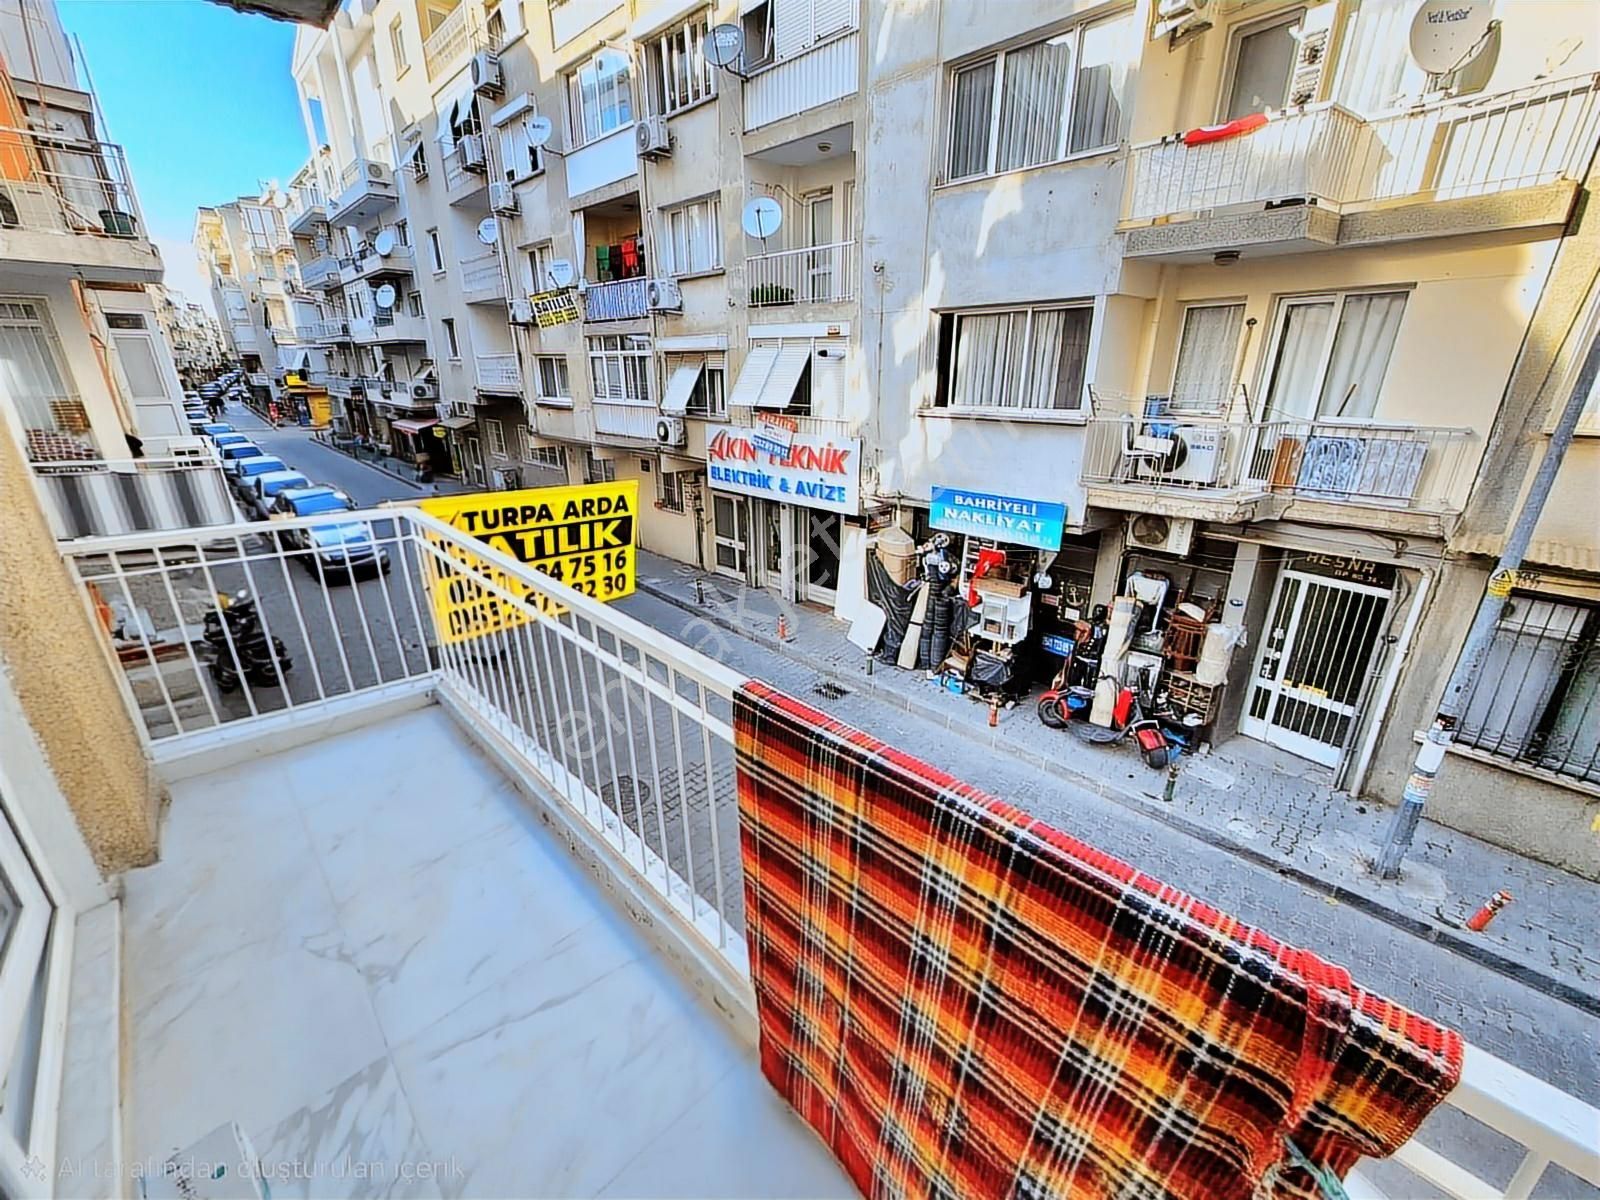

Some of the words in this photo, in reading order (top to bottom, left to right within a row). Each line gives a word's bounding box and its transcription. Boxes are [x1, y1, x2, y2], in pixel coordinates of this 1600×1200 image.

[708, 429, 757, 463] AKIN
[769, 441, 851, 476] KNİK
[710, 465, 774, 491] ELEKTRİK
[779, 476, 792, 494] &
[795, 478, 846, 503] AVİZE
[461, 503, 553, 532] TURPA
[562, 494, 629, 521] ARDA
[943, 507, 1046, 533] NAKLİYAT
[954, 494, 1037, 517] BAHRİYELİ
[466, 519, 623, 568] ATILIK
[568, 555, 596, 579] 75
[603, 550, 627, 572] 16
[602, 572, 626, 595] 30
